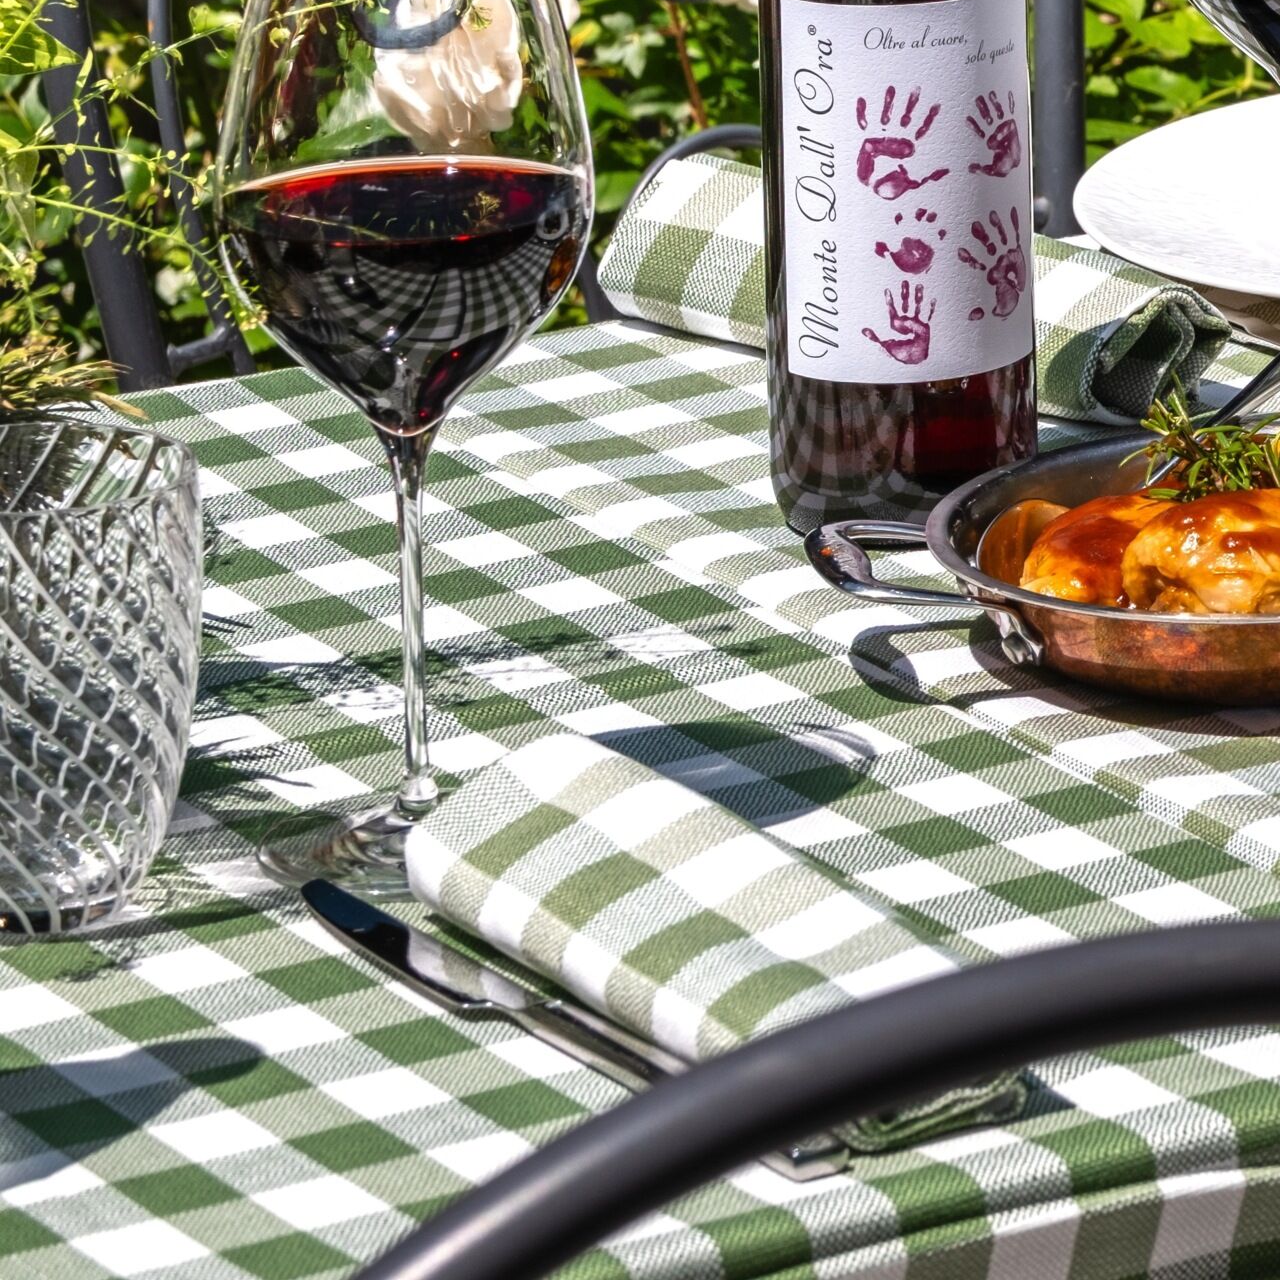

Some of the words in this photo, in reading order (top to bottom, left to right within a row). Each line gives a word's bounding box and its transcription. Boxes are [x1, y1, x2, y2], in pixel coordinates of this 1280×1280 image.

[863, 26, 905, 50] Oltre
[911, 24, 931, 48] al
[931, 34, 968, 48] cuore,
[965, 39, 987, 65] solo
[989, 38, 1015, 65] queste
[795, 125, 837, 222] Dall'
[798, 239, 839, 359] Monte
